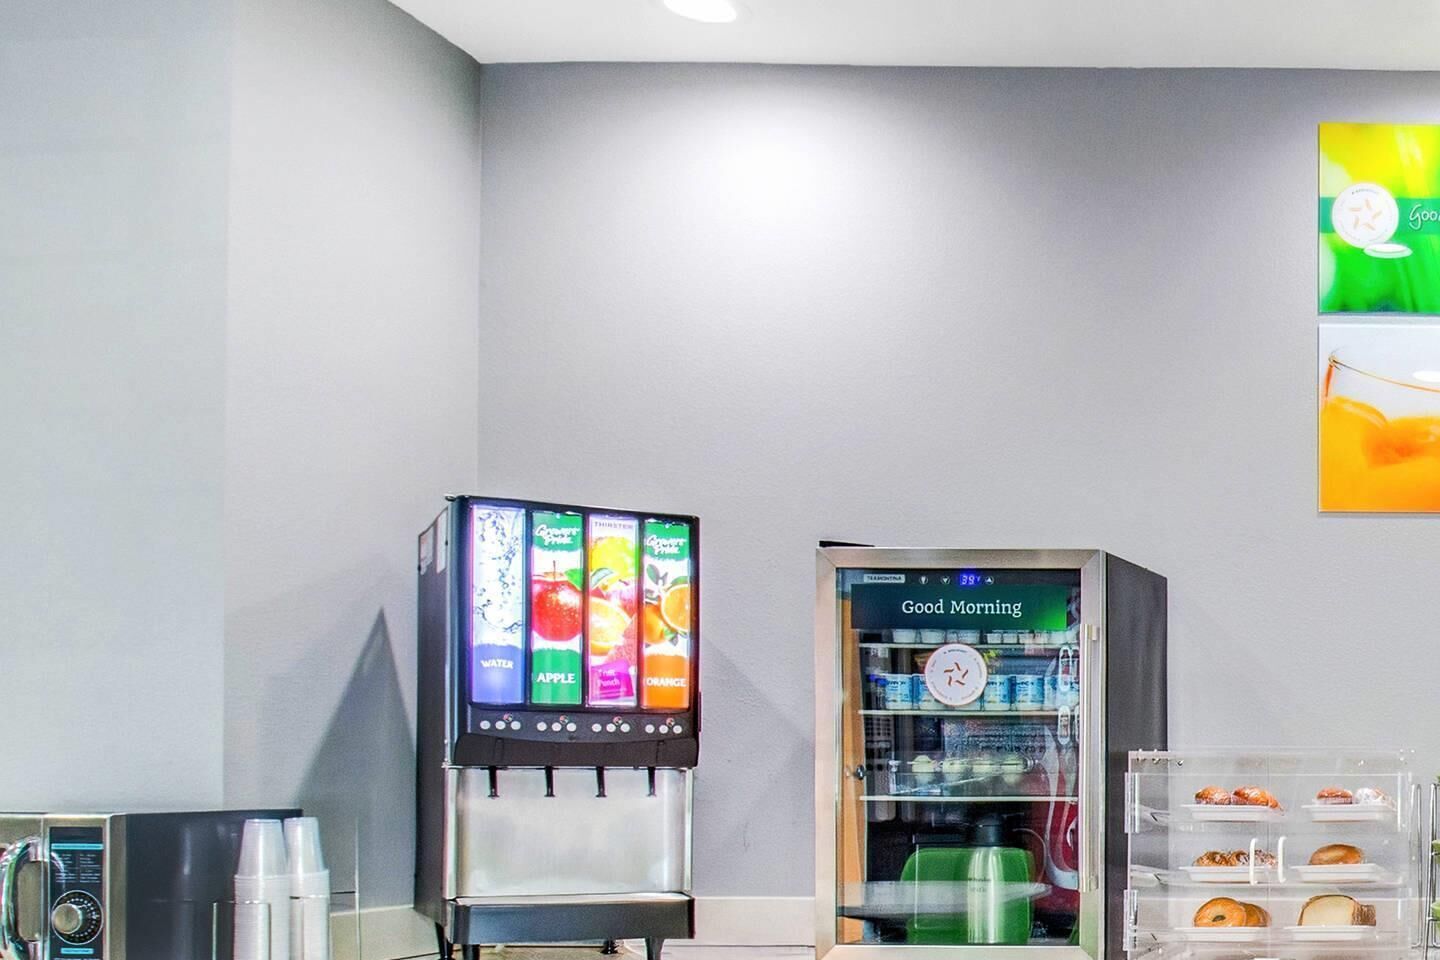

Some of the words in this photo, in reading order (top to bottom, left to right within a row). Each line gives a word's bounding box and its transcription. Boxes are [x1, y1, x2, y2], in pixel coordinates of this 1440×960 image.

[902, 599, 945, 614] Good
[950, 600, 1022, 617] Morning
[480, 659, 514, 669] WATER
[536, 673, 576, 684] APPLE
[646, 678, 687, 687] ORANGE
